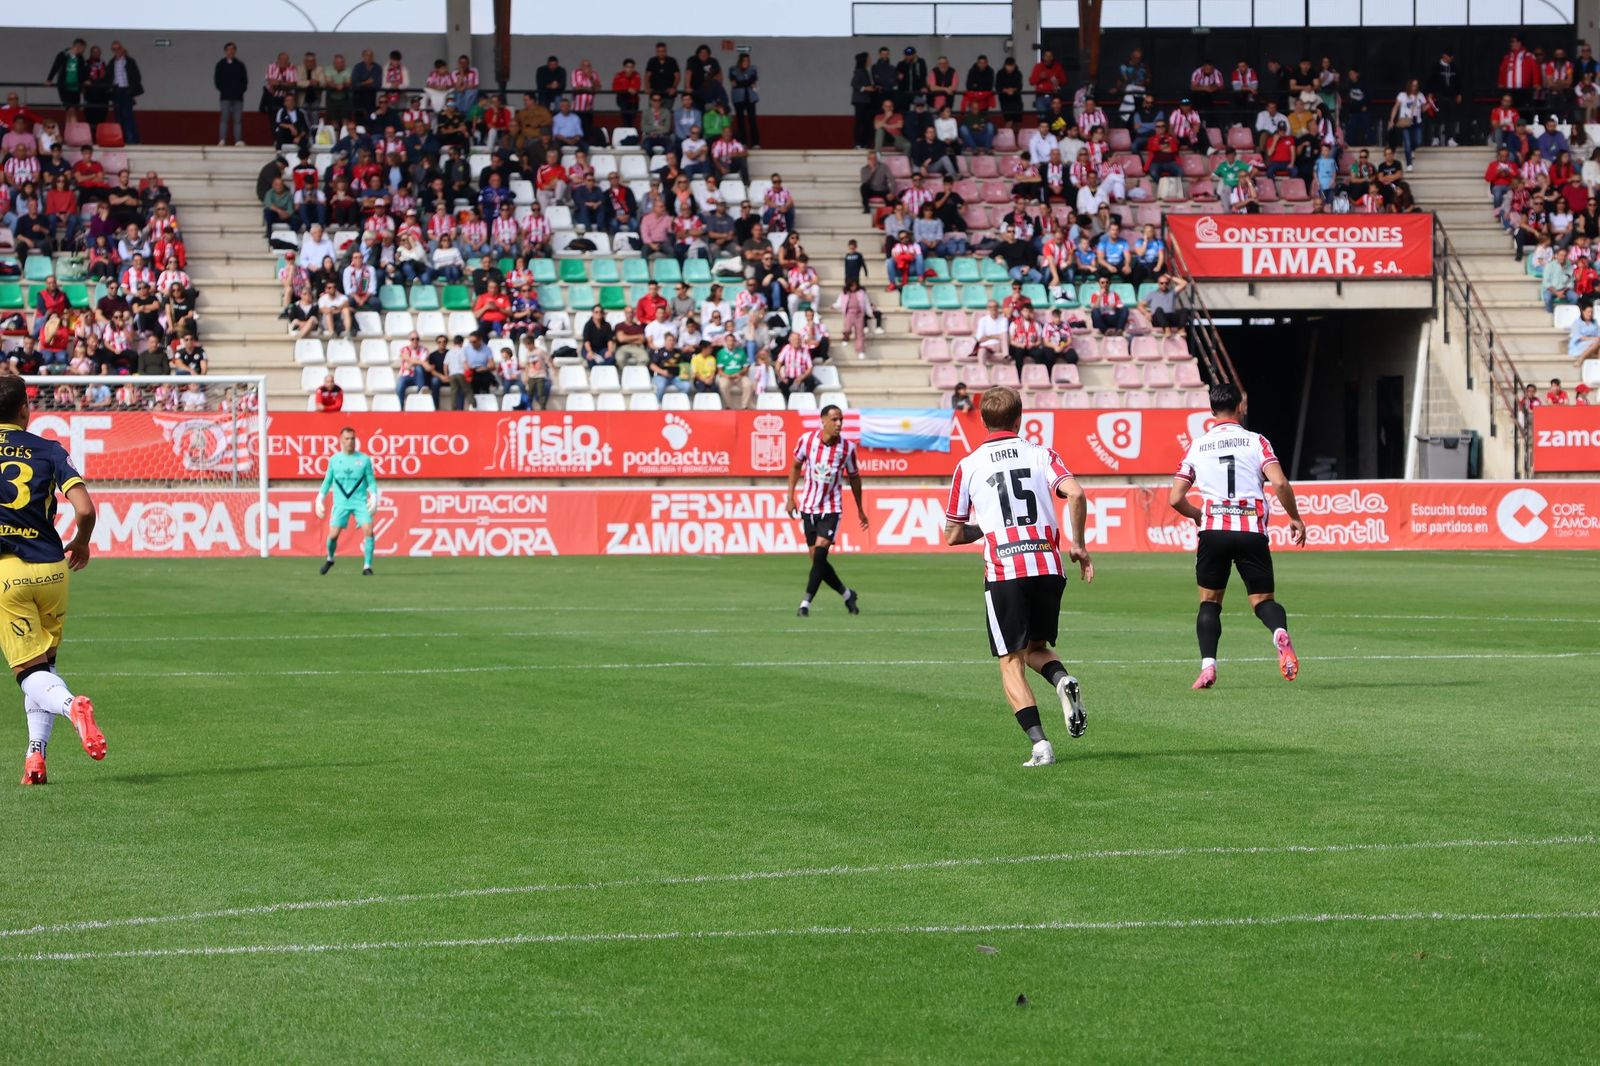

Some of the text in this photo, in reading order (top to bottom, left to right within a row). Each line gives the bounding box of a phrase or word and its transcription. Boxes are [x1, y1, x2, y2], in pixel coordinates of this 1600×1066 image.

[1372, 260, 1403, 274] S.A.
[368, 428, 470, 456] ÓPTICO
[516, 414, 600, 451] fisio
[1113, 418, 1132, 449] 8
[297, 455, 421, 475] RORTO
[857, 458, 908, 471] MIENTO
[990, 448, 1019, 463] LOREN
[1086, 432, 1120, 471] ZAMORA
[0, 461, 34, 511] 3
[986, 467, 1038, 528] 15
[651, 492, 803, 520] PERSIANA
[1210, 505, 1257, 516] leomotor.net
[1262, 488, 1389, 516] scuela
[1411, 503, 1488, 516] Escucha todos
[1552, 503, 1585, 516] COPE
[243, 501, 312, 550] CF
[876, 497, 948, 546] ZAM
[1411, 520, 1488, 536] los partidos en
[1553, 516, 1600, 529] ZAMOR
[408, 527, 560, 557] ZAMORA
